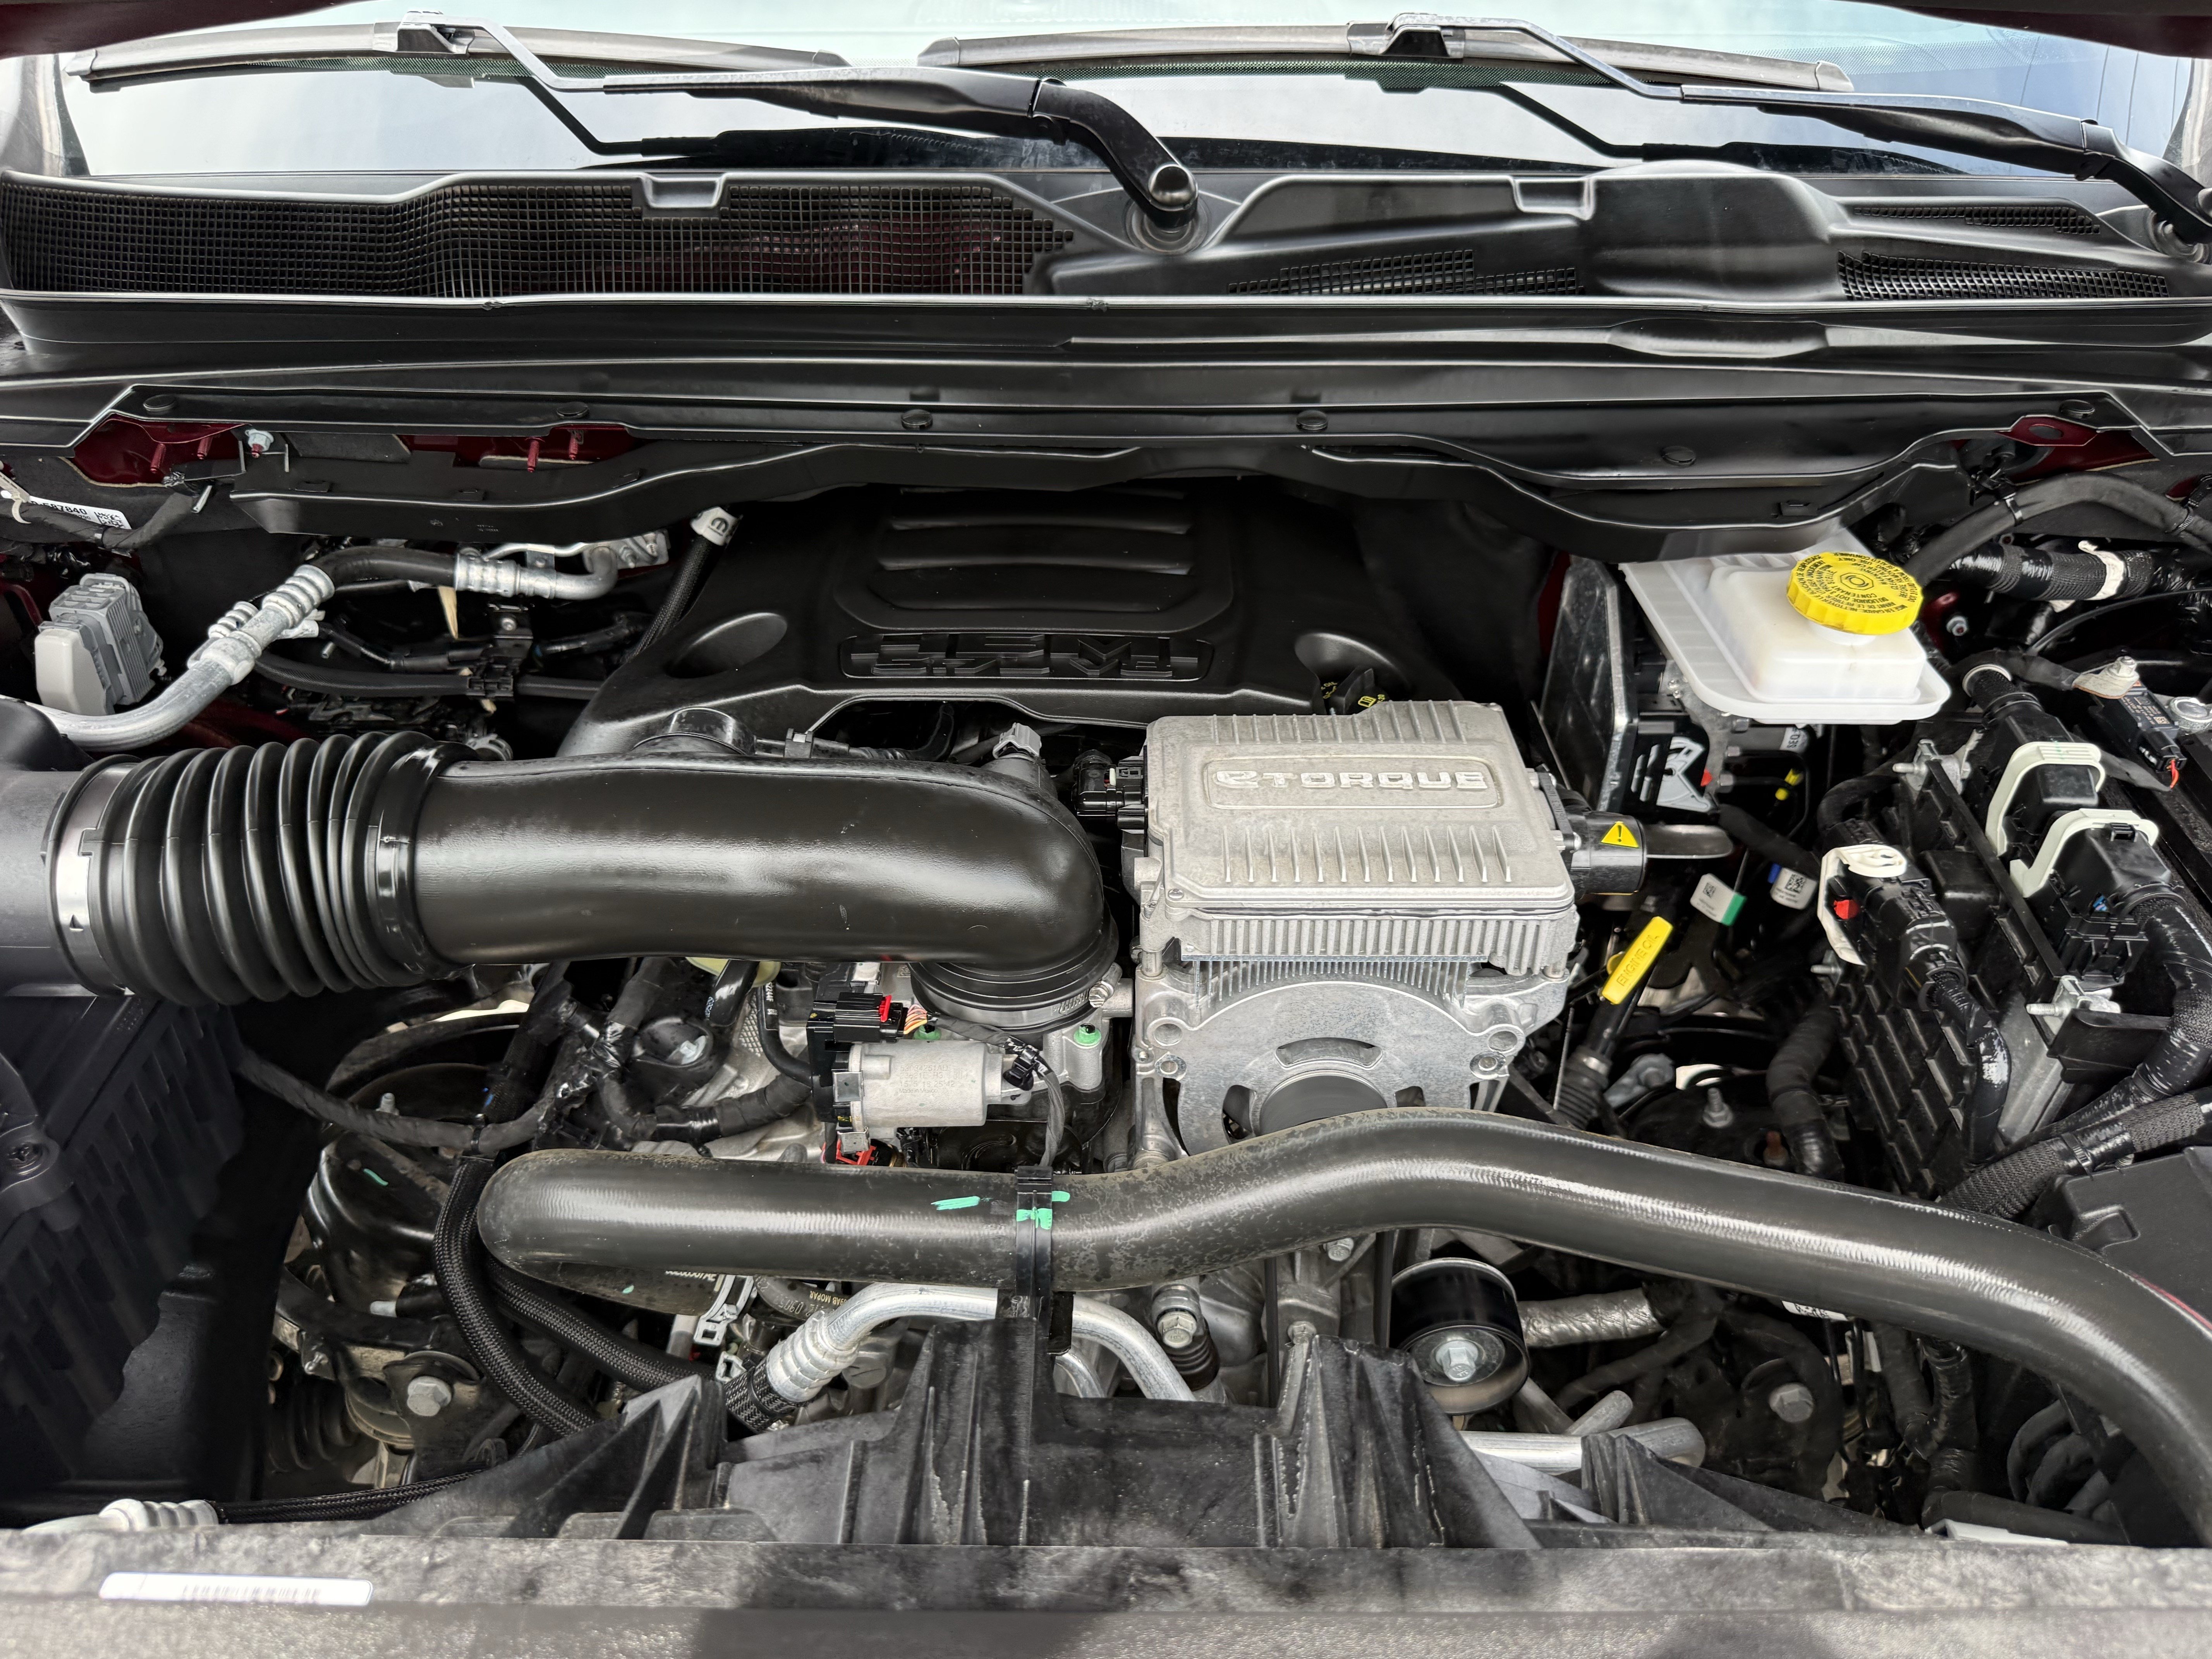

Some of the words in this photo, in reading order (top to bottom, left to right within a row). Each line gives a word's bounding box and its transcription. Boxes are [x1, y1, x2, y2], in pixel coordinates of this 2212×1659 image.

[1831, 586, 1877, 598] CONTENANT
[1821, 599, 1857, 611] NETTOYER
[1616, 948, 1647, 986] ENGINE
[1642, 934, 1660, 950] OIL
[810, 1291, 831, 1304] MOPAR
